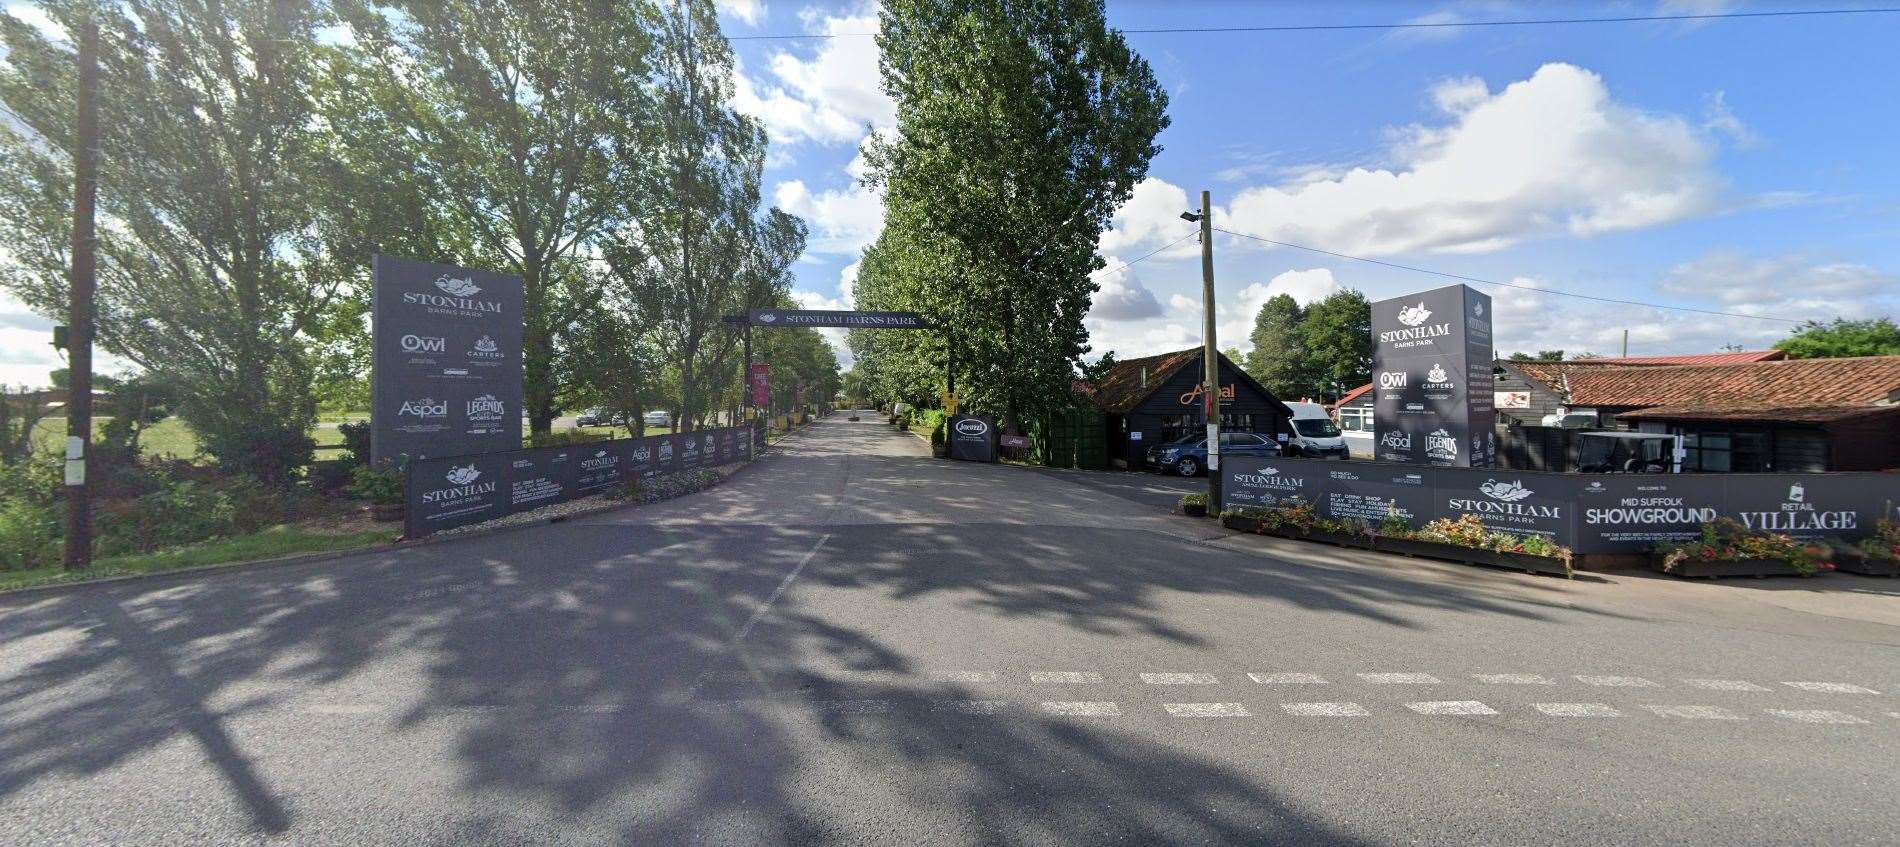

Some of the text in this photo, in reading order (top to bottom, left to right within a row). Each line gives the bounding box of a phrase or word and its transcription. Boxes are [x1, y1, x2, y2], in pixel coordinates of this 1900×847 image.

[403, 291, 502, 313] STONHAM
[427, 306, 483, 319] BARNS PARK
[785, 315, 917, 325] STONHAM BARNS PARK
[1380, 323, 1451, 343] STONHAM
[401, 334, 445, 352] Owl
[1394, 339, 1434, 349] BARNS PARK
[1380, 371, 1406, 387] Owl
[1180, 383, 1235, 405] Aal
[398, 400, 447, 419] Aspal
[466, 400, 505, 416] LEGENDS
[1381, 432, 1411, 450] Aspal
[1425, 435, 1458, 455] LEGENDS
[581, 456, 619, 470] STONHAM
[1234, 473, 1304, 488] STONHAM
[422, 481, 496, 505] STONHAM
[1449, 498, 1561, 519] STONHAM
[1621, 498, 1683, 507] MID SUFFOLK
[1781, 503, 1815, 511] RETAIL
[1508, 516, 1535, 524] PARK
[1585, 507, 1717, 525] SHOWGROUND
[1739, 511, 1857, 530] VILLAGE
